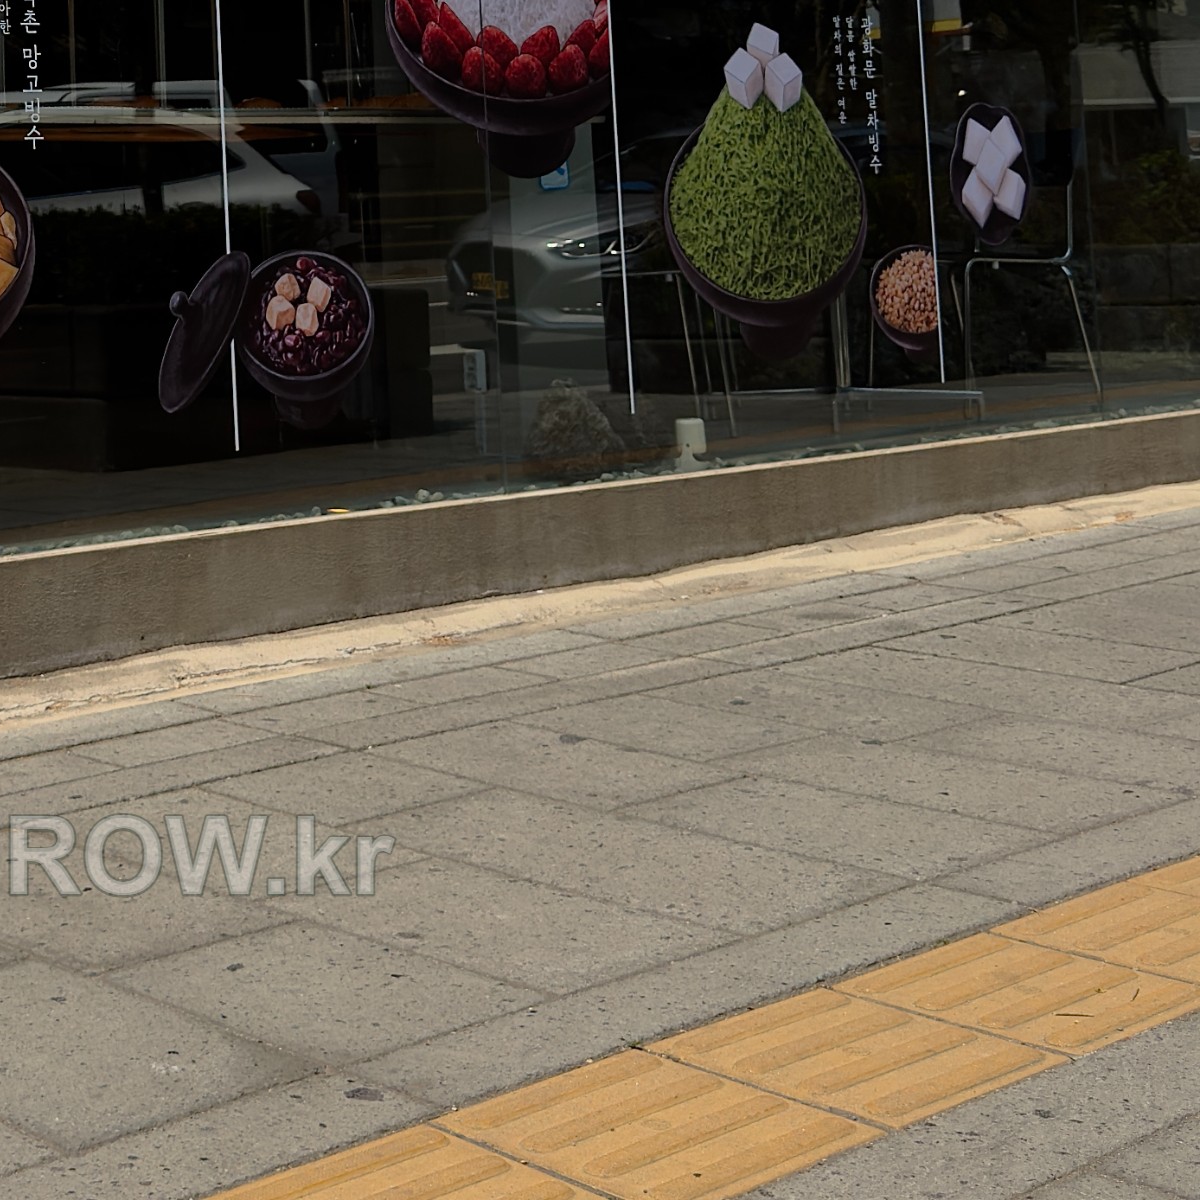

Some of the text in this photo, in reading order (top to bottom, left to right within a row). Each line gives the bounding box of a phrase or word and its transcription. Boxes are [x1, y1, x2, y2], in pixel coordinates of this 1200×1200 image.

[22, 43, 45, 150] 망고빙수
[860, 16, 884, 176] 광화문 말차빙수
